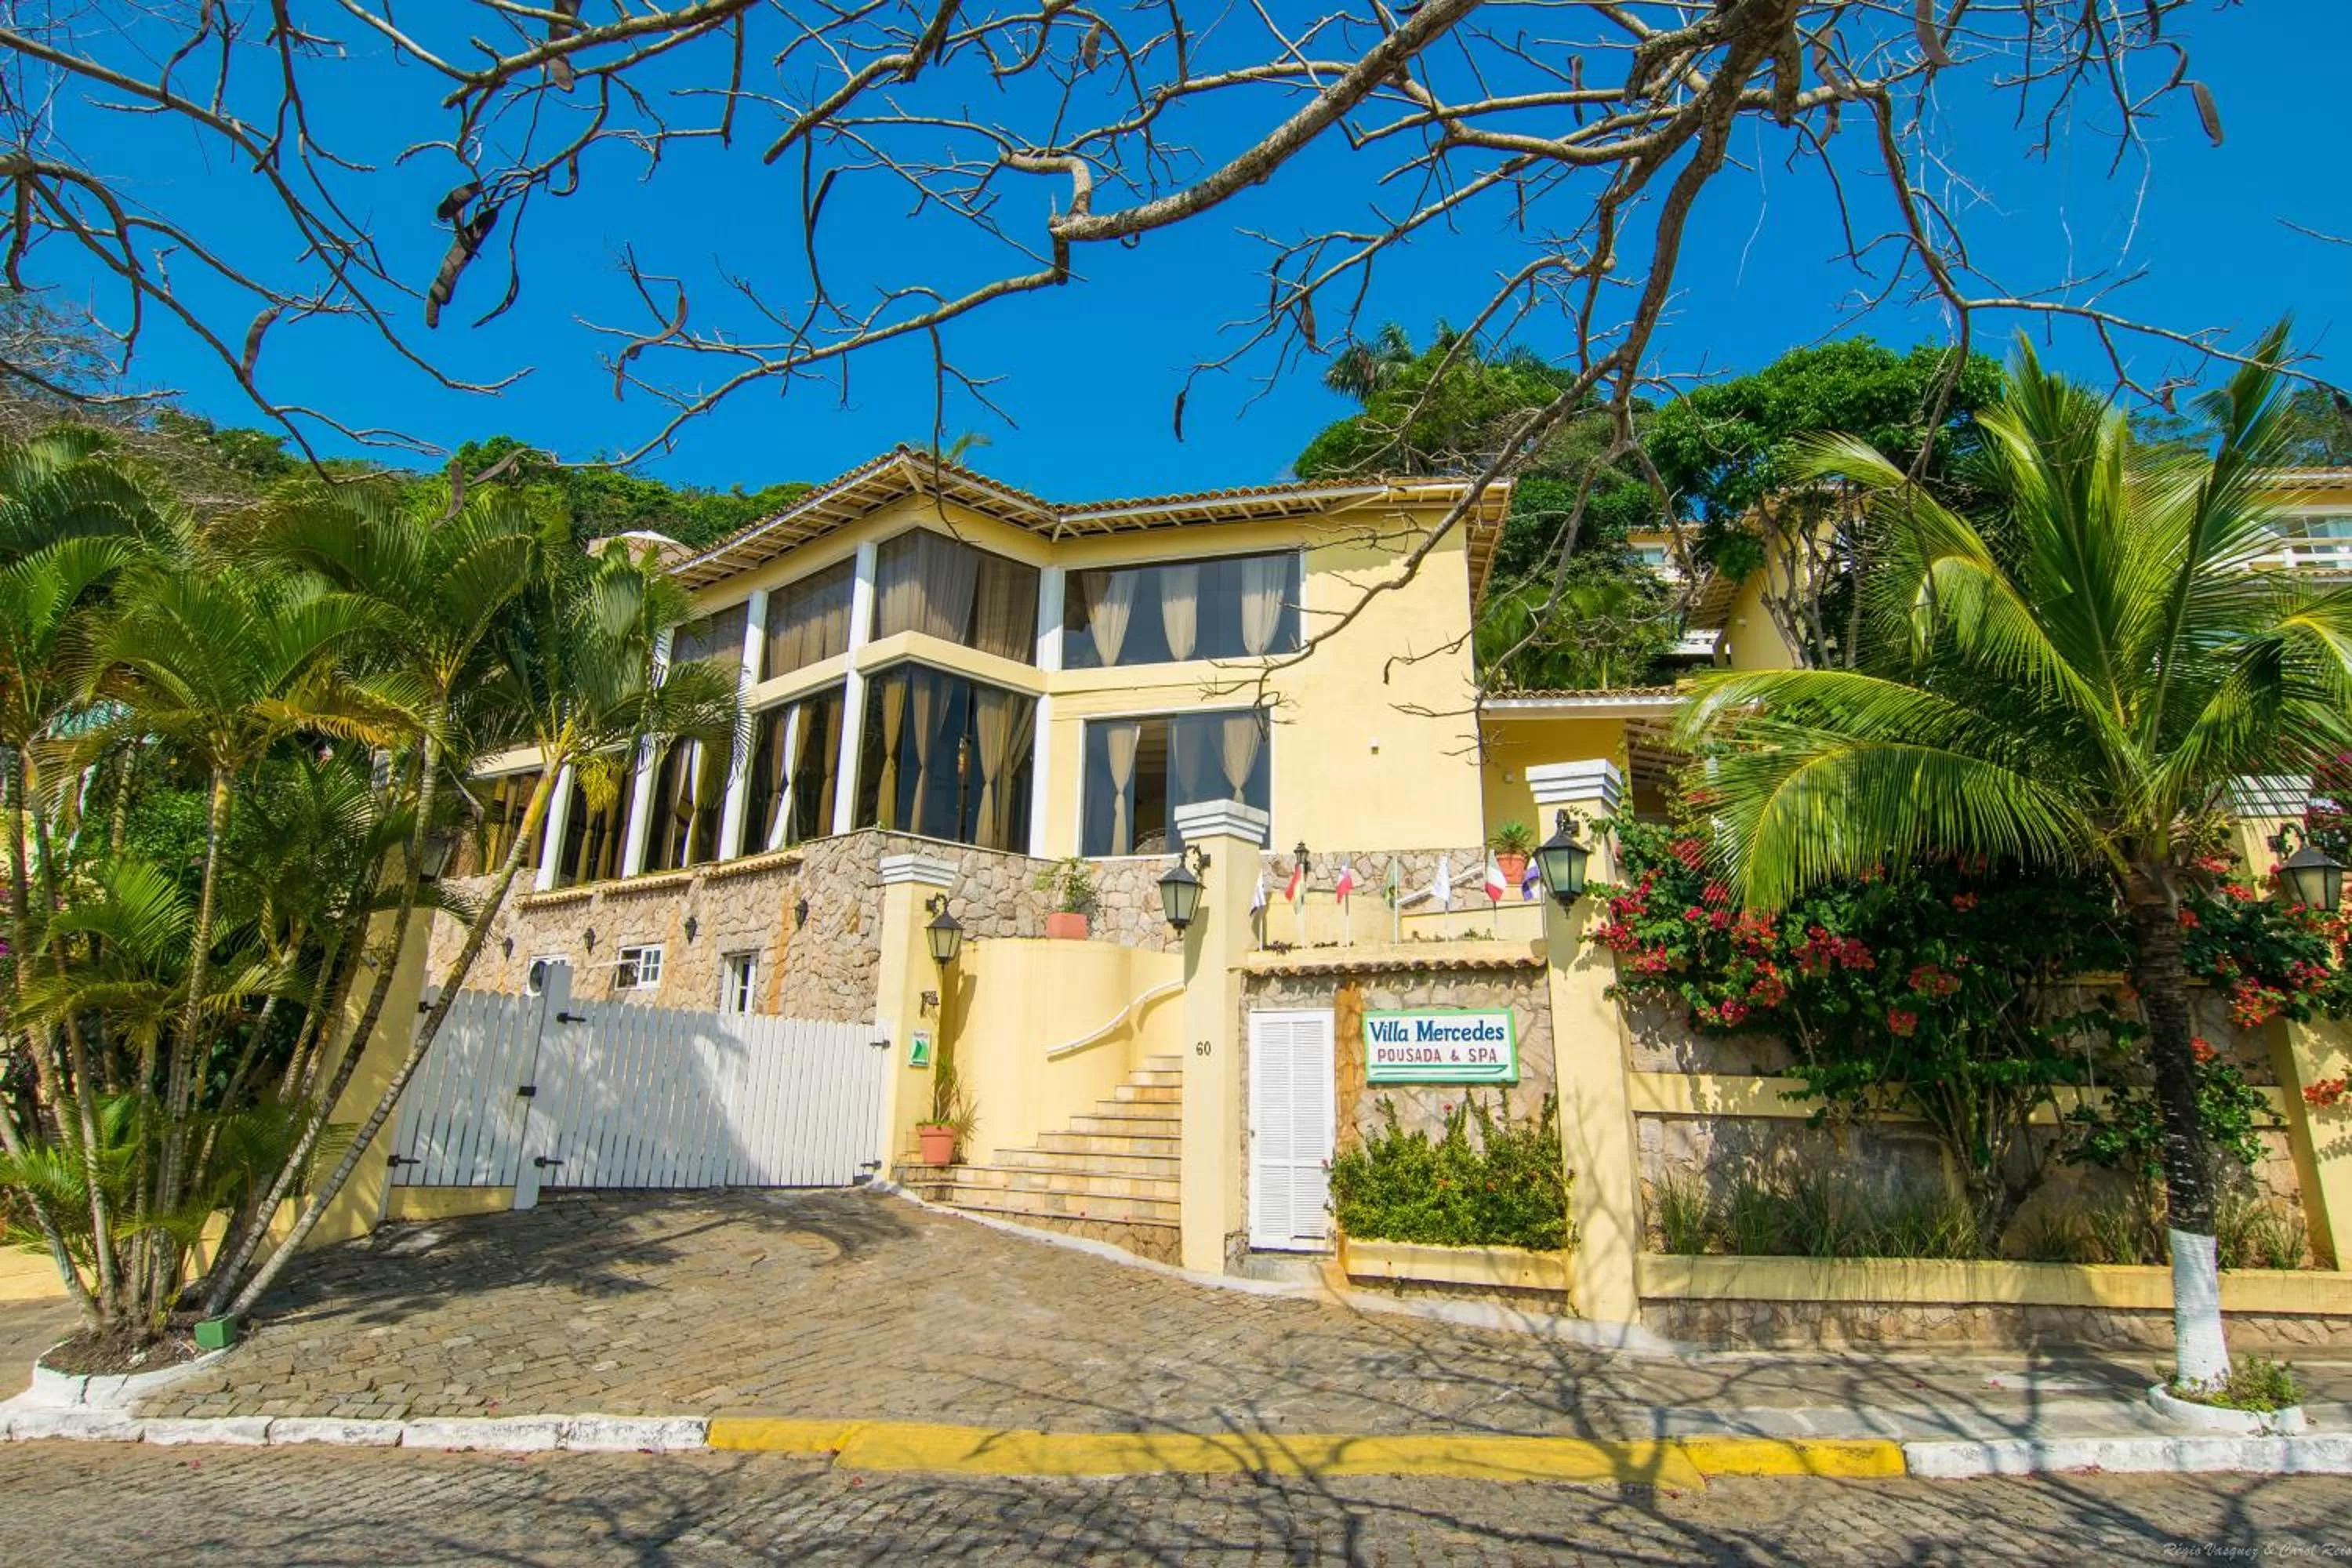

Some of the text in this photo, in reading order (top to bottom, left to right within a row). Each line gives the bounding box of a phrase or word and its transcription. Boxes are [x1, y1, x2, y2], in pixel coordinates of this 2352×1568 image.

[1369, 1020, 1504, 1041] Villa Mercedes
[1196, 1040, 1211, 1056] 60
[1377, 1048, 1497, 1063] POUSADA & SPA
